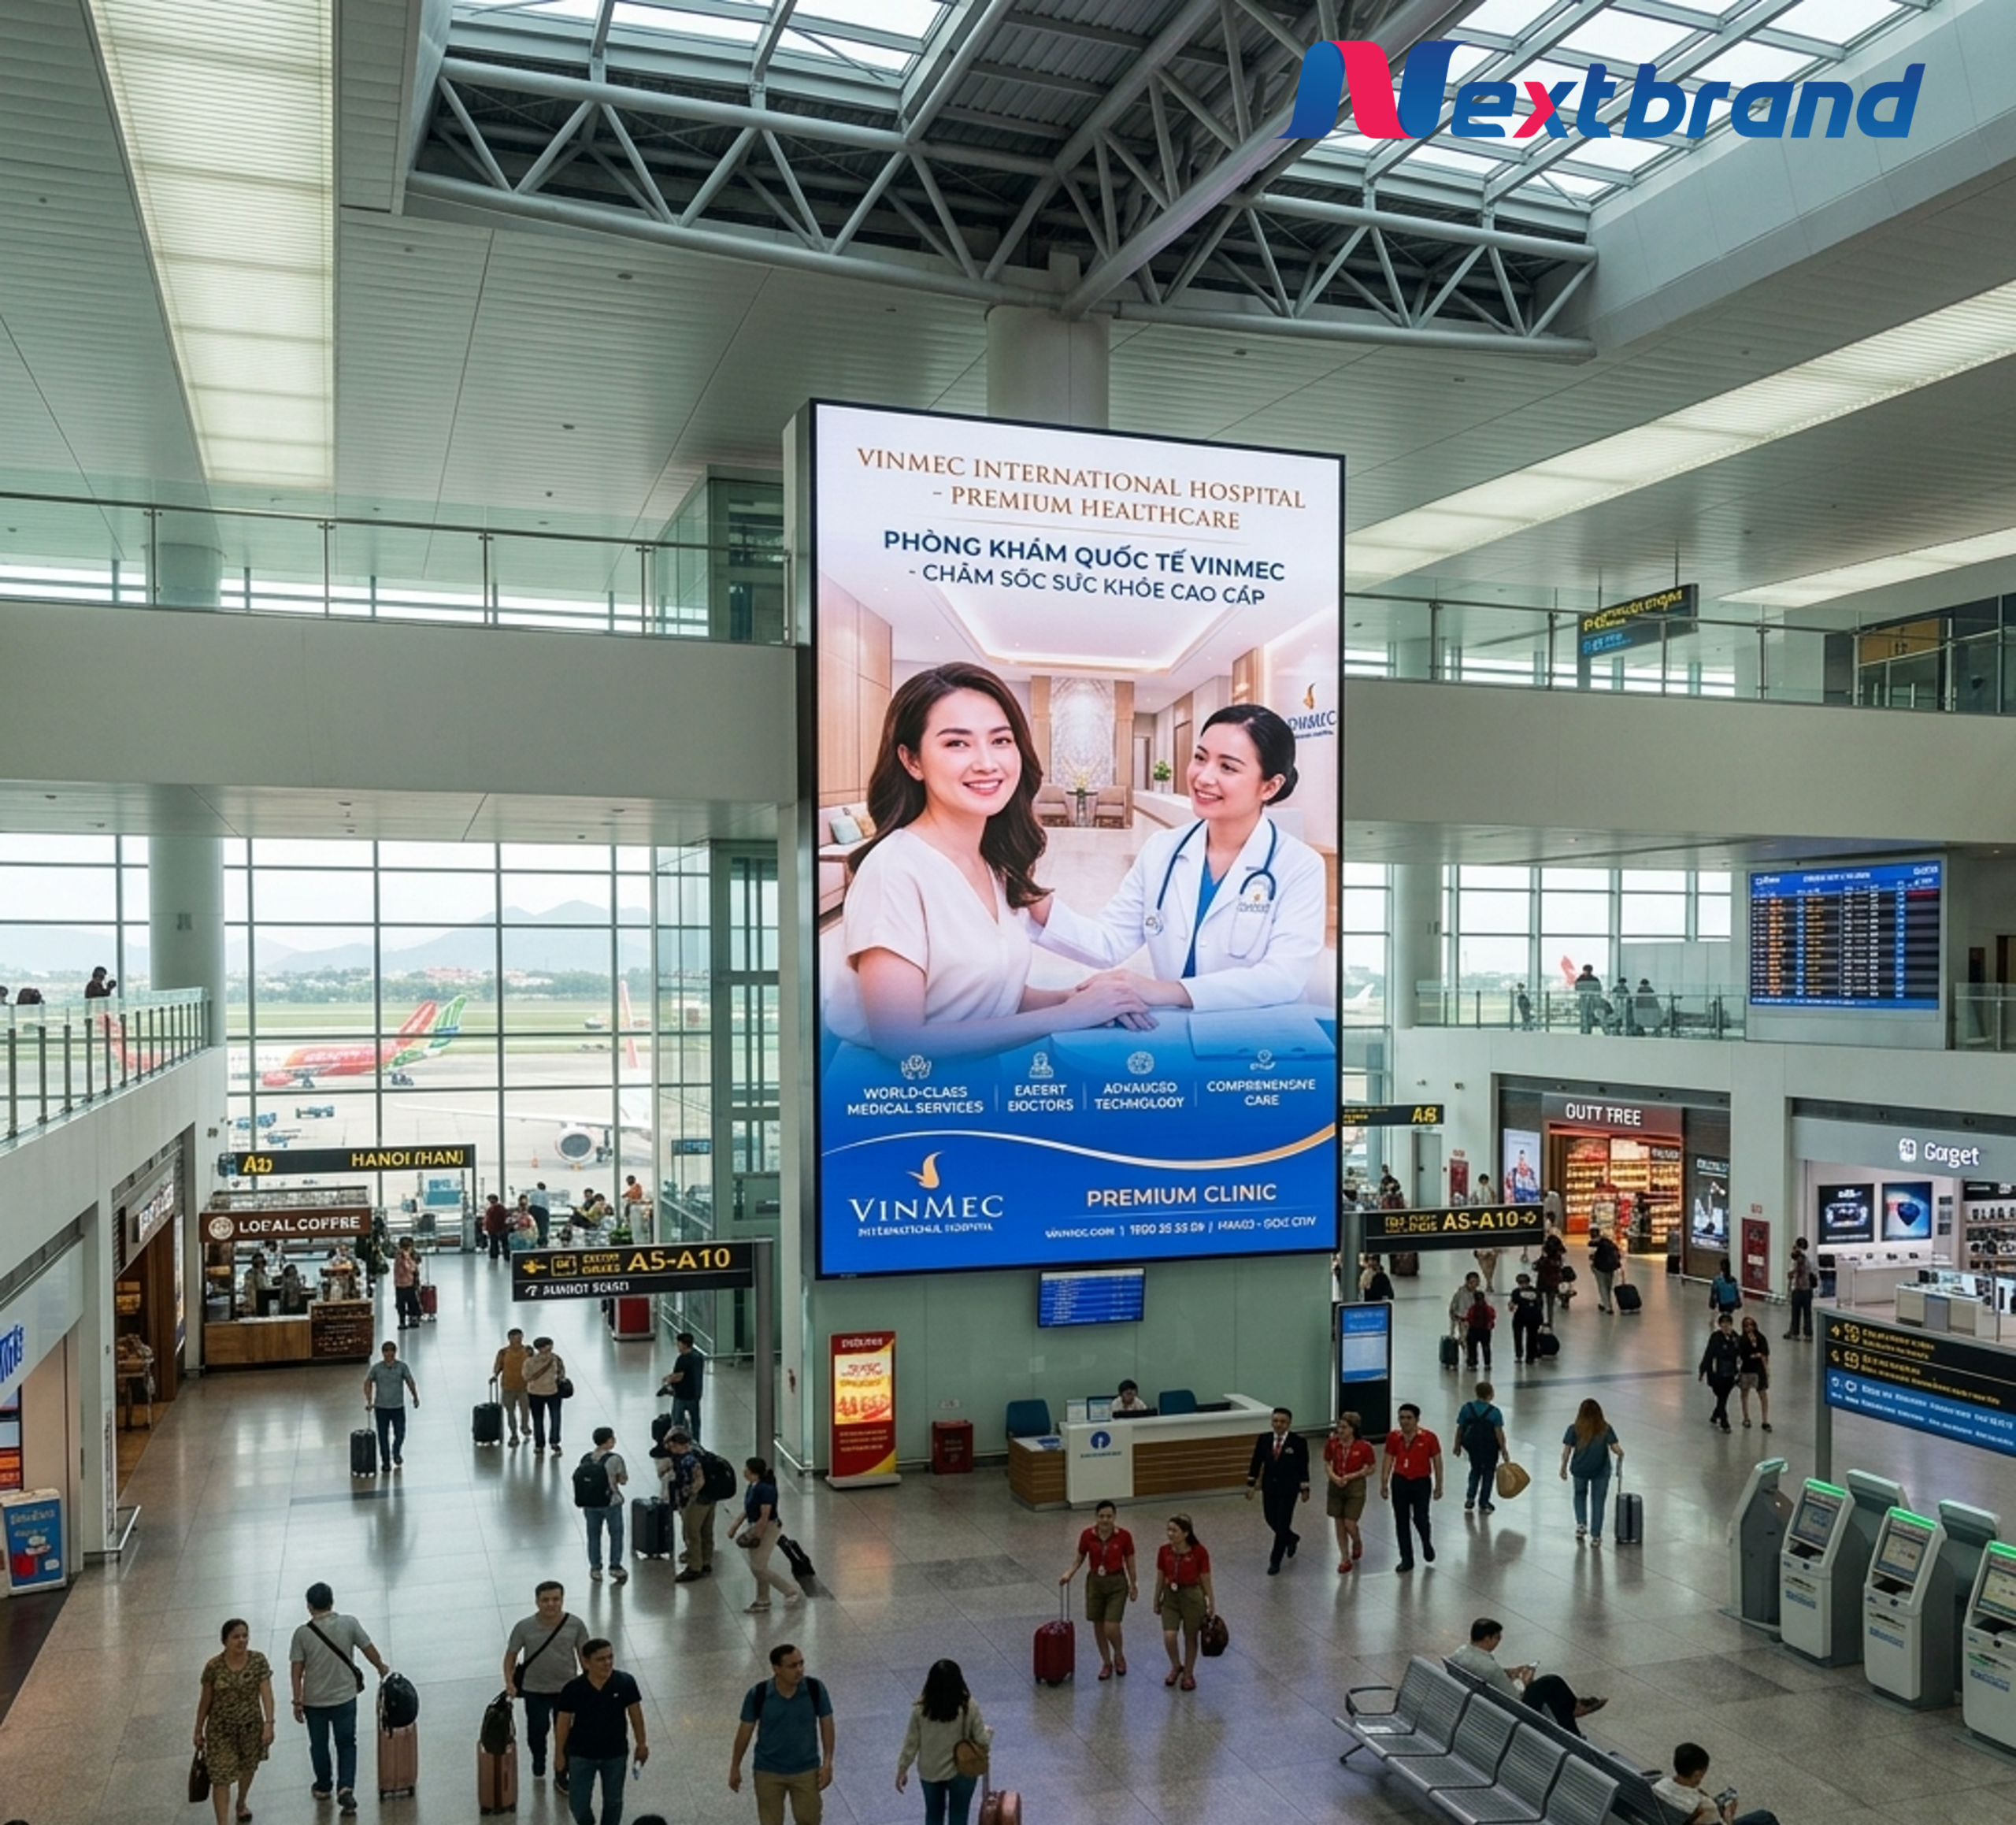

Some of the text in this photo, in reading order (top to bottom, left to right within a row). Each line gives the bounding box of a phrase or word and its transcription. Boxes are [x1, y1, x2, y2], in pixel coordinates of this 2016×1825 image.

[858, 447, 1306, 509] VINMEC INTERNATIONAL HOSPITAL
[951, 485, 1073, 515] PREMIUM
[1080, 498, 1240, 530] HEALTHCARE
[884, 529, 982, 556] PHÒNG
[989, 537, 1067, 563] KHÁM
[1074, 544, 1149, 570] QUỐC
[1191, 555, 1285, 581] VINMEC
[1170, 583, 1217, 603] CAO
[847, 1100, 984, 1116] MEDICAL SERVICES
[1244, 1094, 1280, 1107] CARE
[1606, 1106, 1642, 1126] FREE
[351, 1152, 410, 1167] HANOI
[1087, 1183, 1277, 1207] PREMIUM CLINIC
